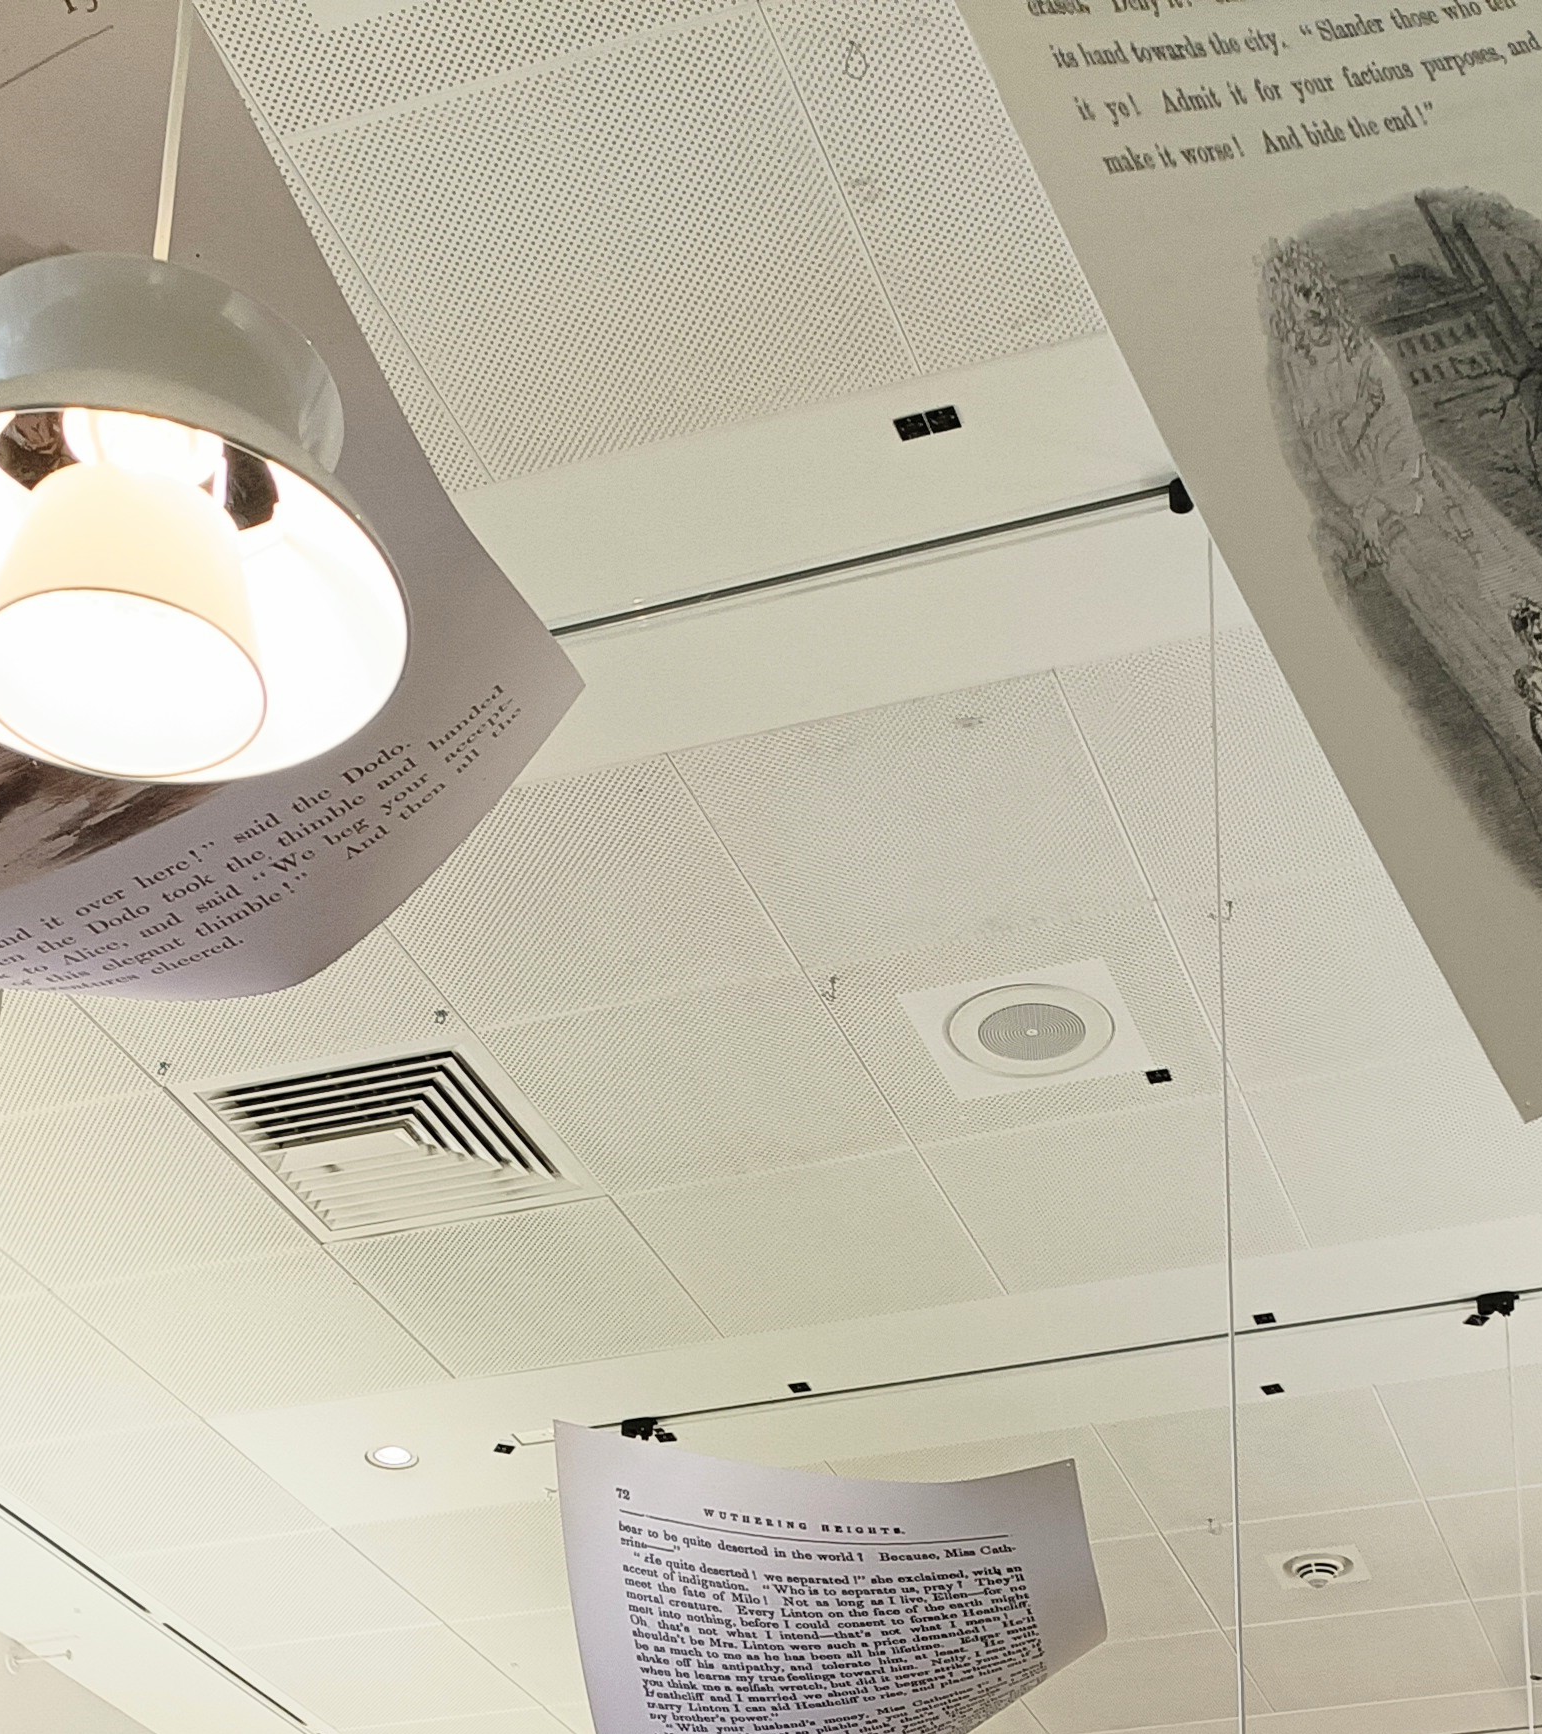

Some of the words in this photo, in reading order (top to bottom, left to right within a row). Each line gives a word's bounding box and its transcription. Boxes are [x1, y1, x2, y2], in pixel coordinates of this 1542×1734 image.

[1049, 44, 1079, 68] its
[1078, 40, 1130, 67] hand
[1130, 34, 1207, 63] towards
[1208, 32, 1241, 56] the
[1389, 7, 1439, 30] those
[1440, 0, 1482, 20] who
[1073, 96, 1096, 121] it
[1161, 85, 1222, 114] Admit
[1226, 82, 1248, 105] it
[1253, 79, 1282, 102] for
[1291, 77, 1335, 104] your
[1341, 61, 1414, 88] factious
[1419, 47, 1507, 82] purposes,
[1507, 29, 1542, 56] and
[1102, 147, 1155, 174] make
[1154, 143, 1177, 168] it
[1179, 135, 1245, 164] worse!
[1262, 125, 1303, 154] And
[1304, 119, 1346, 147] bide
[1347, 115, 1380, 139] the
[36, 936, 76, 953] the
[85, 905, 150, 934] Dodo
[162, 874, 215, 902] took
[277, 795, 364, 847] thimble
[376, 757, 416, 790] and
[427, 684, 503, 751] handed
[41, 916, 64, 930] it
[75, 889, 125, 916] over
[233, 812, 281, 843] said
[292, 789, 331, 813] the
[341, 743, 410, 784] Dodo.
[139, 912, 183, 938] and
[195, 884, 242, 914] said
[322, 818, 369, 846] beg
[380, 773, 427, 816] your
[102, 937, 186, 971] elegant
[346, 825, 388, 860] And
[399, 783, 446, 820] then
[151, 935, 244, 974] cheered.
[615, 1487, 630, 1500] 72
